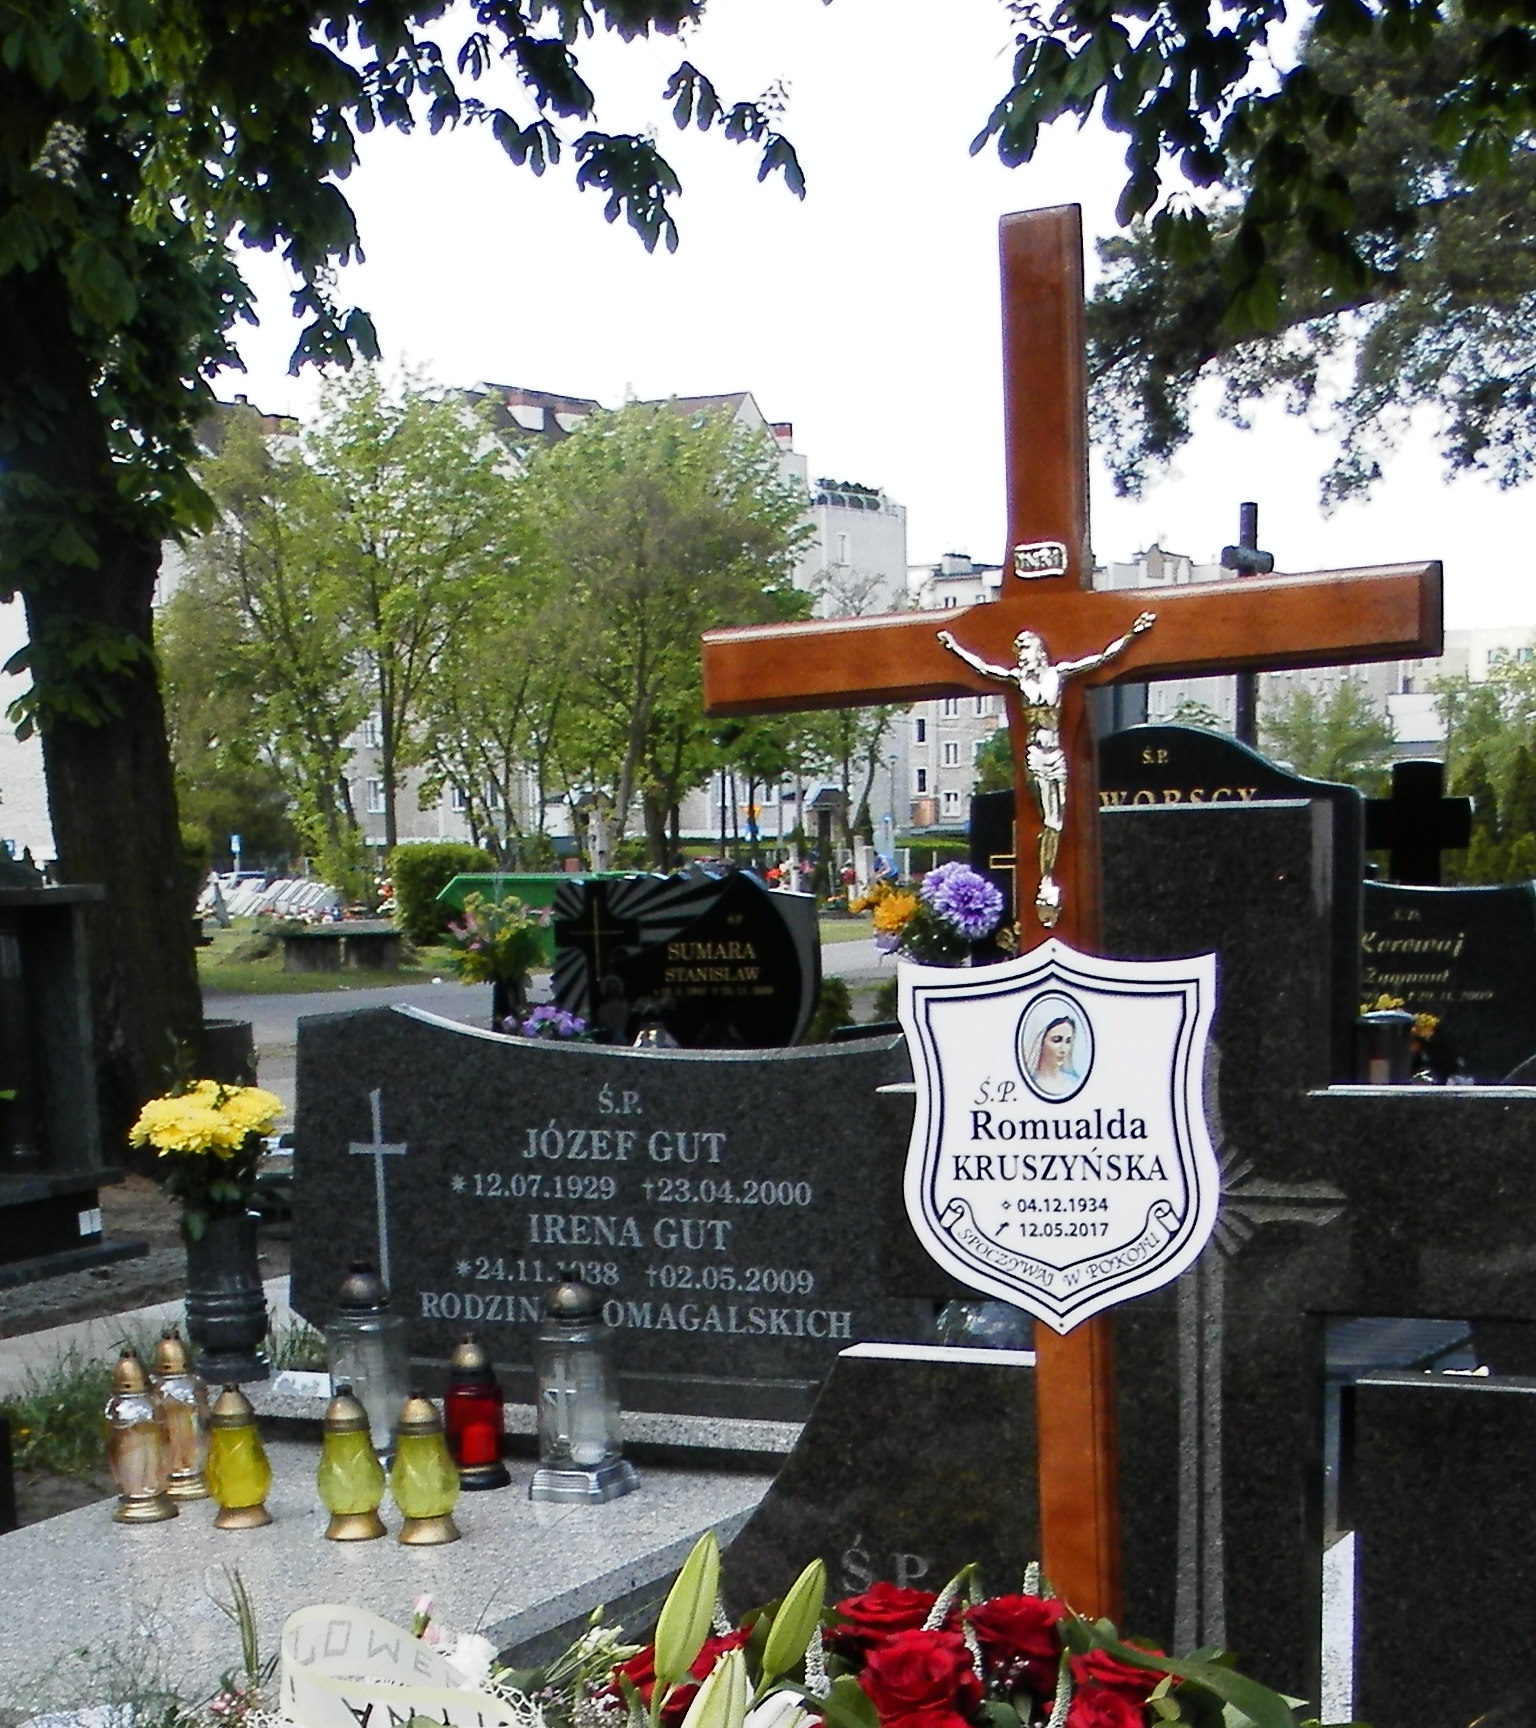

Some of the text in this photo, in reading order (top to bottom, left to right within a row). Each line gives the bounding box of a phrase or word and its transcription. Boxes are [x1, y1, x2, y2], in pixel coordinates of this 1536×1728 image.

[668, 942, 756, 960] SUMARA
[522, 1119, 726, 1164] JÓZEF GUT
[970, 1108, 1148, 1141] Romualda
[953, 1147, 1168, 1181] KRUSZYŃSKA
[1017, 1198, 1108, 1213] 04.12.1934
[529, 1213, 731, 1252] IRENA GUT
[1020, 1222, 1109, 1237] 12.05.2017
[958, 1228, 1161, 1288] SPOCZYWAJ W POKOJU
[601, 1301, 852, 1339] OMAGALSKICH
